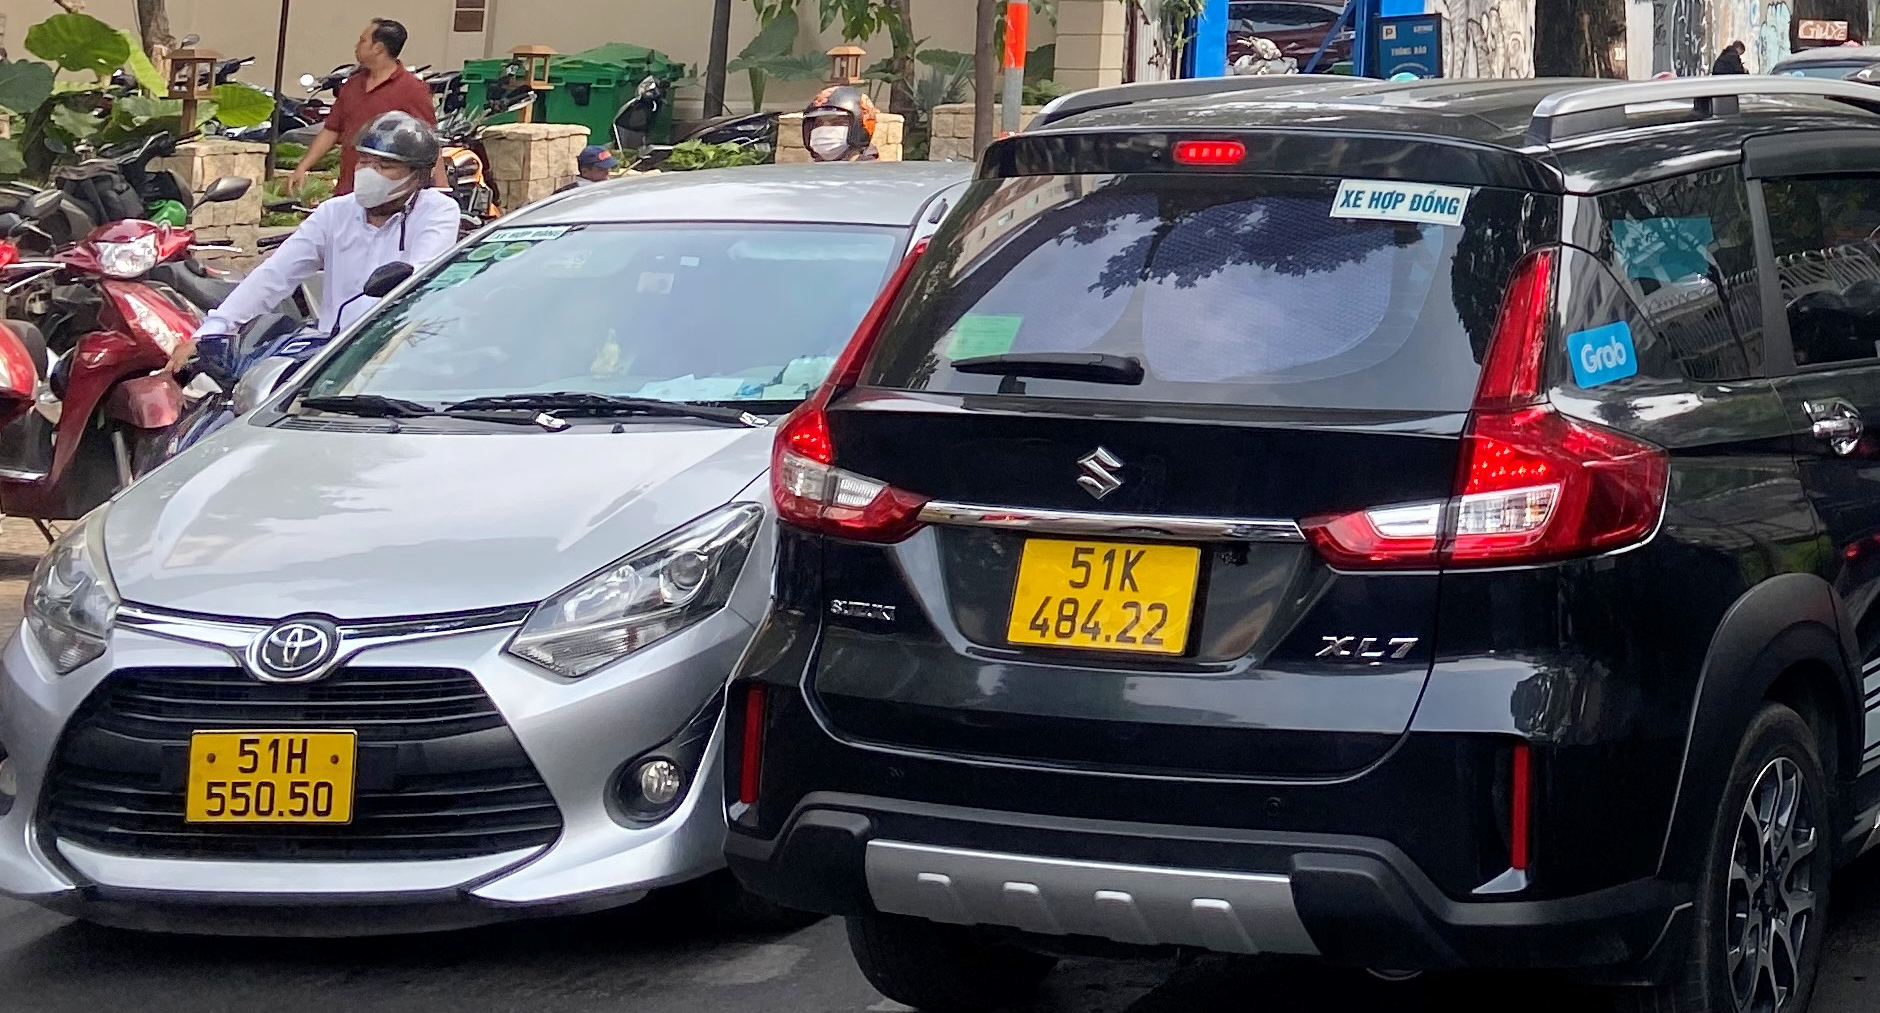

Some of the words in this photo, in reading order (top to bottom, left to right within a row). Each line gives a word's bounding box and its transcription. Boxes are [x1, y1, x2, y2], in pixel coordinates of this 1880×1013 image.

[1340, 189, 1365, 209] XE
[1368, 189, 1407, 214] HỢP
[1581, 335, 1627, 374] Grab
[1069, 547, 1146, 592] 51K
[1029, 596, 1168, 645] 484.22
[1315, 636, 1419, 659] XL7
[238, 738, 308, 774] 51H
[206, 781, 333, 817] 550.50
